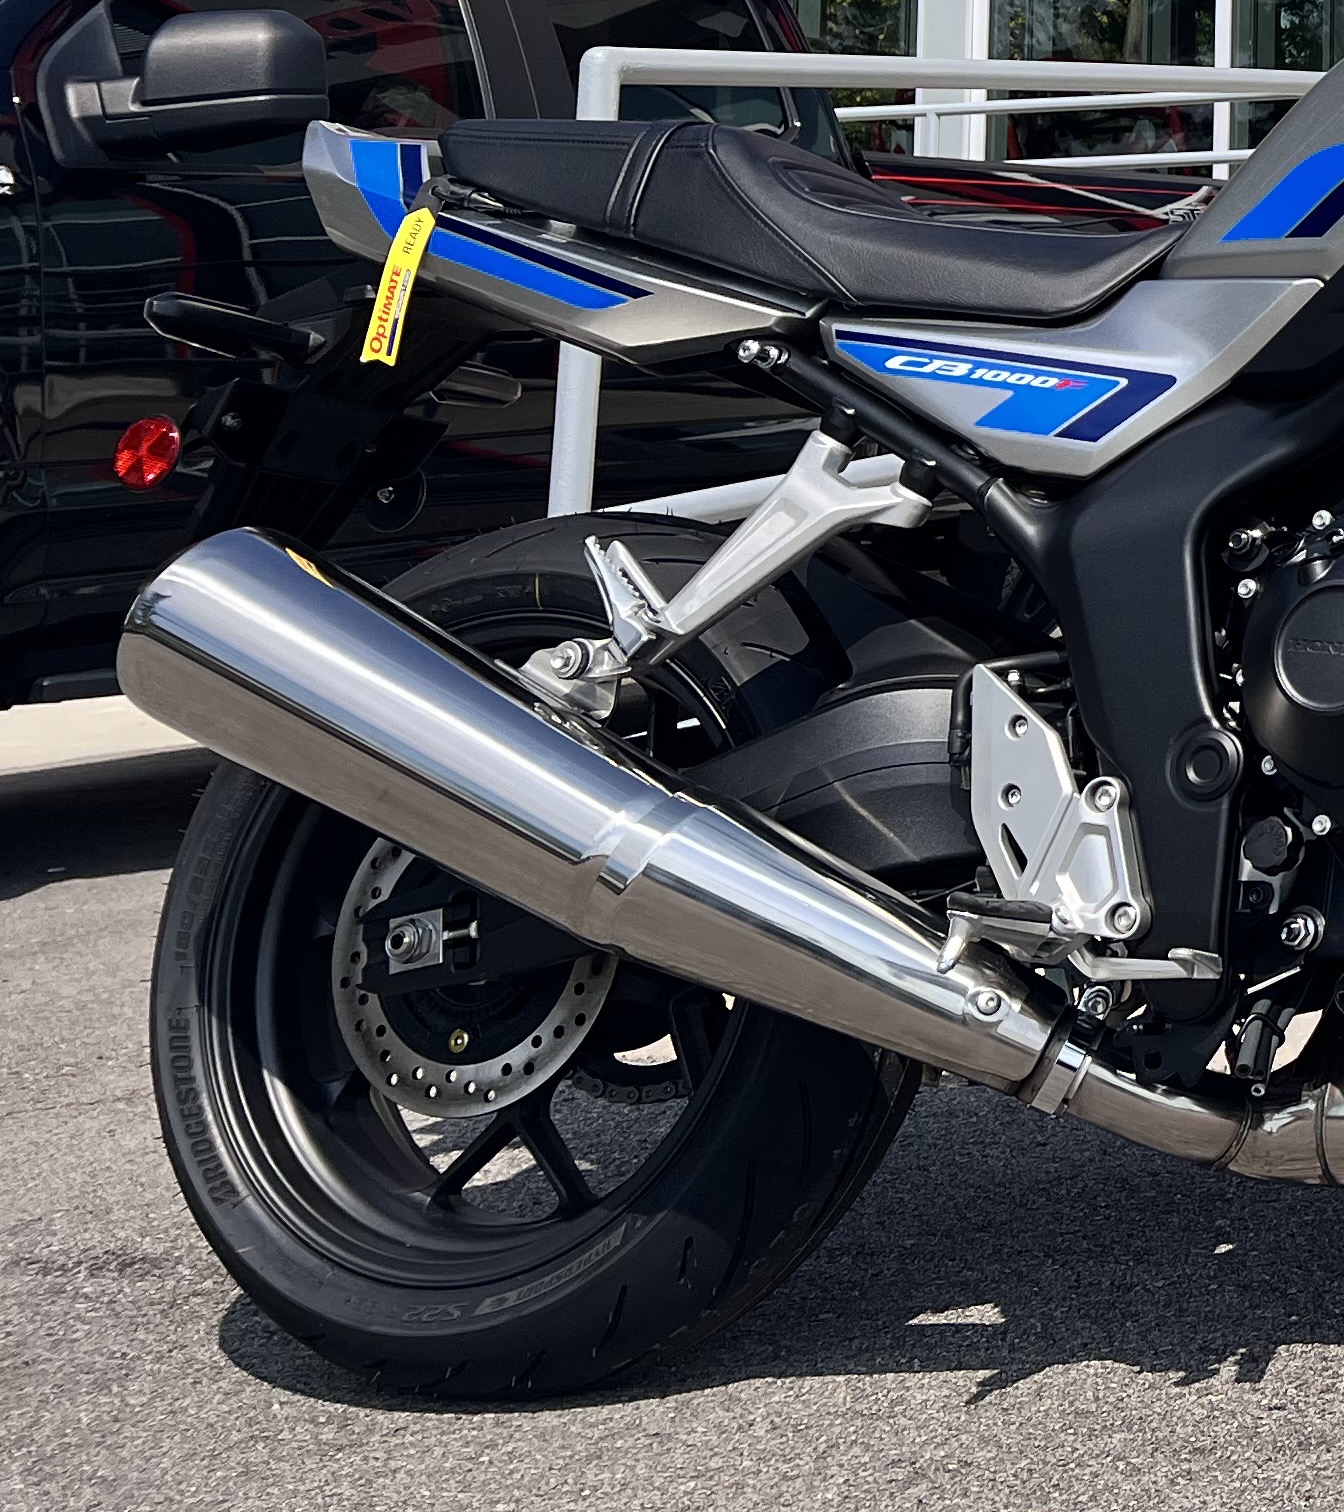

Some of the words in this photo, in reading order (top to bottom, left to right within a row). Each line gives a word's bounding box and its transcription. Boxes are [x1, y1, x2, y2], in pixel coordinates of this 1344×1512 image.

[402, 216, 425, 255] READY
[369, 264, 403, 355] OptiMATE
[169, 1016, 241, 1208] BRIDGESTONE
